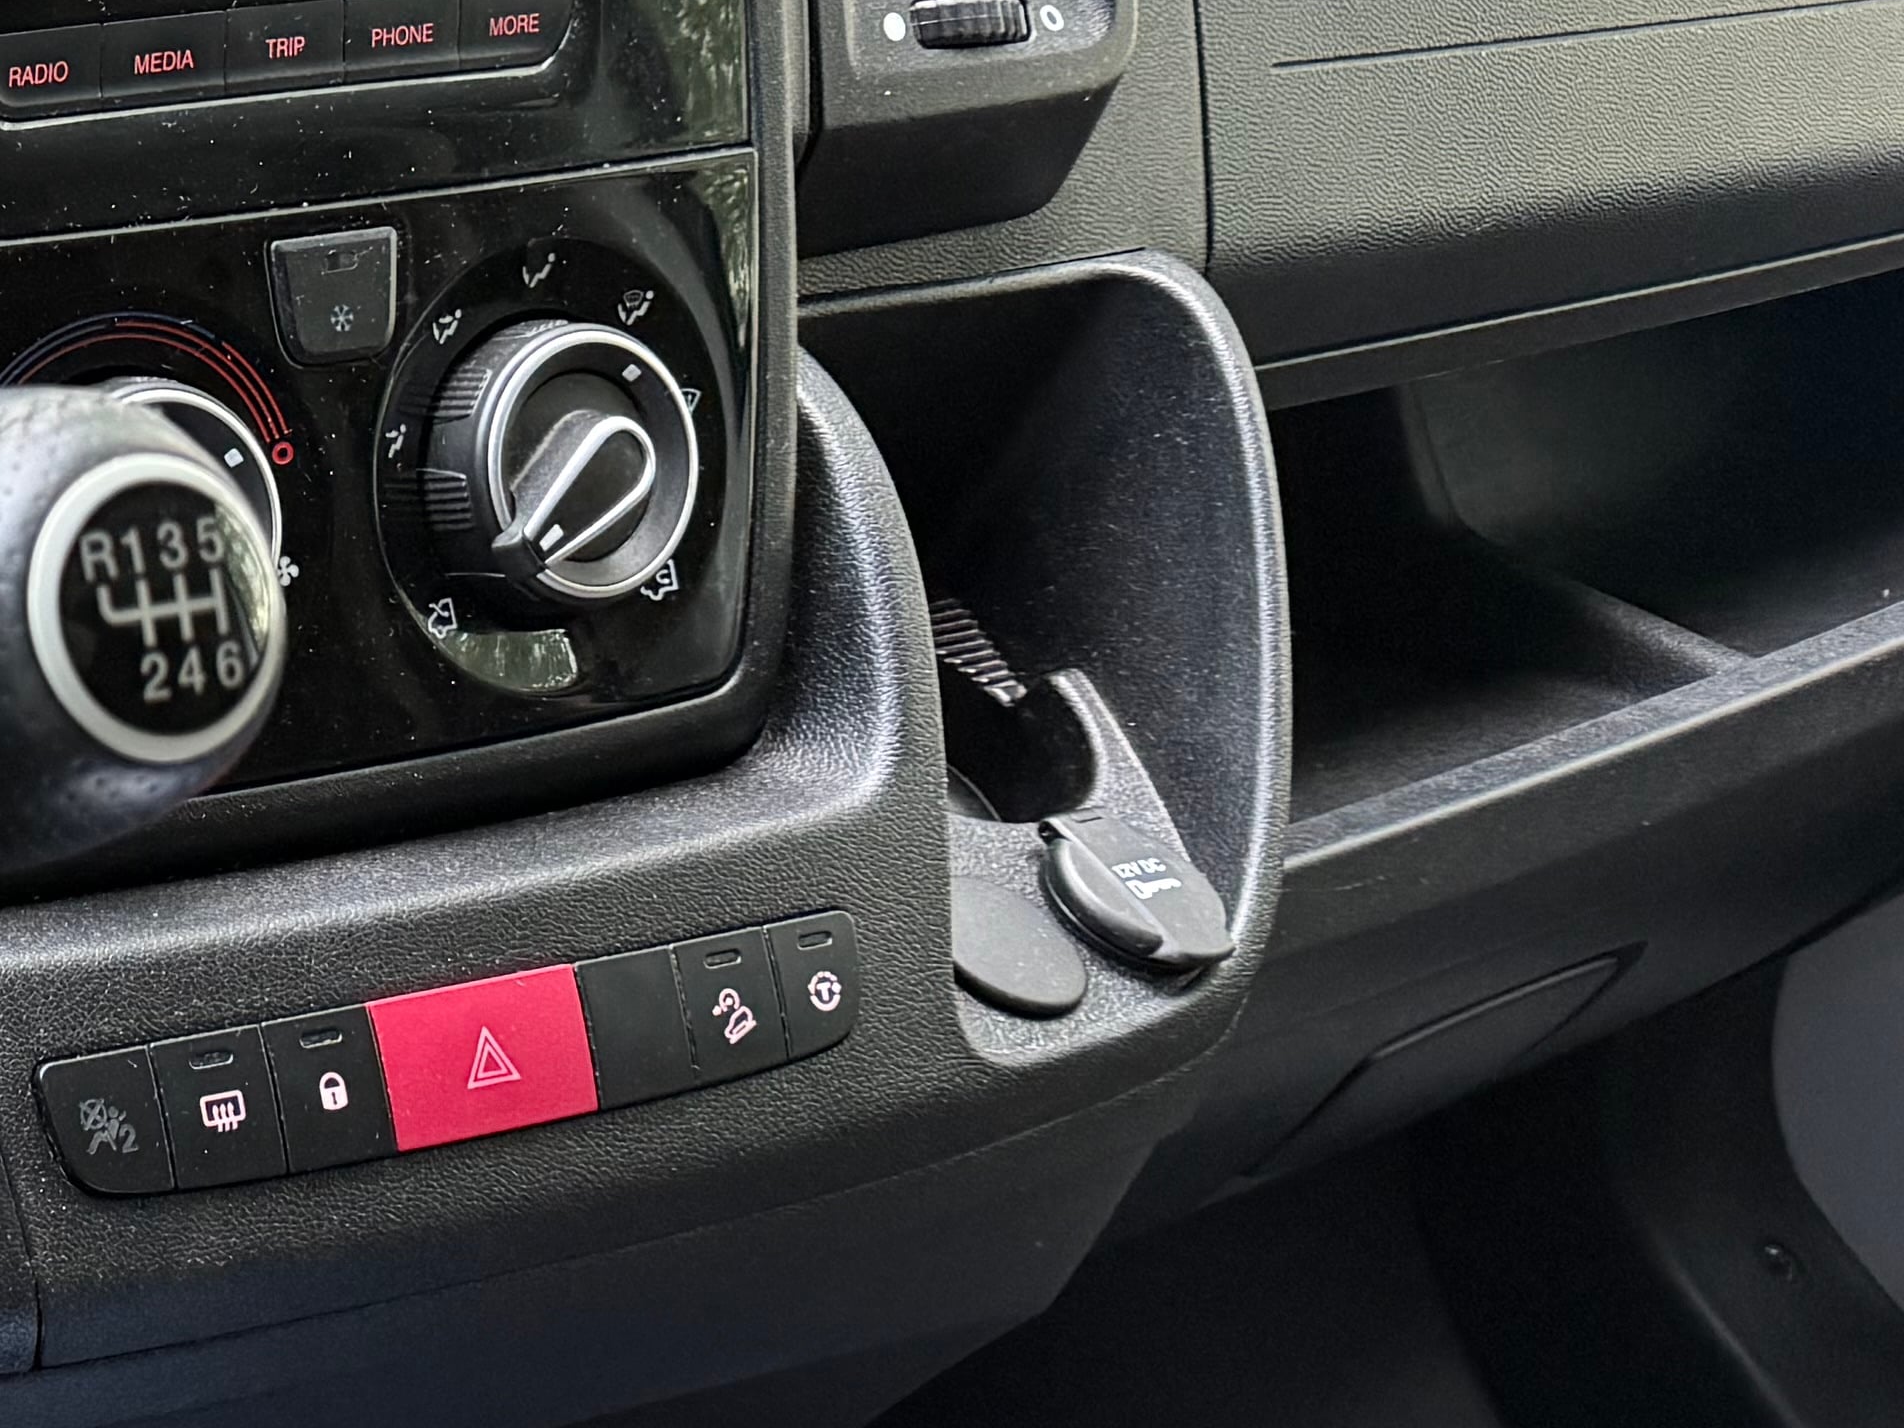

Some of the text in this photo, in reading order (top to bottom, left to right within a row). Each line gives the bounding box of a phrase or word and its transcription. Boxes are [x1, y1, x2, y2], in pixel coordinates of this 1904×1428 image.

[370, 22, 435, 49] PHONE
[488, 12, 541, 38] MORE
[264, 36, 306, 60] TRIP
[7, 60, 70, 88] RADIO
[132, 48, 195, 76] MEDIA
